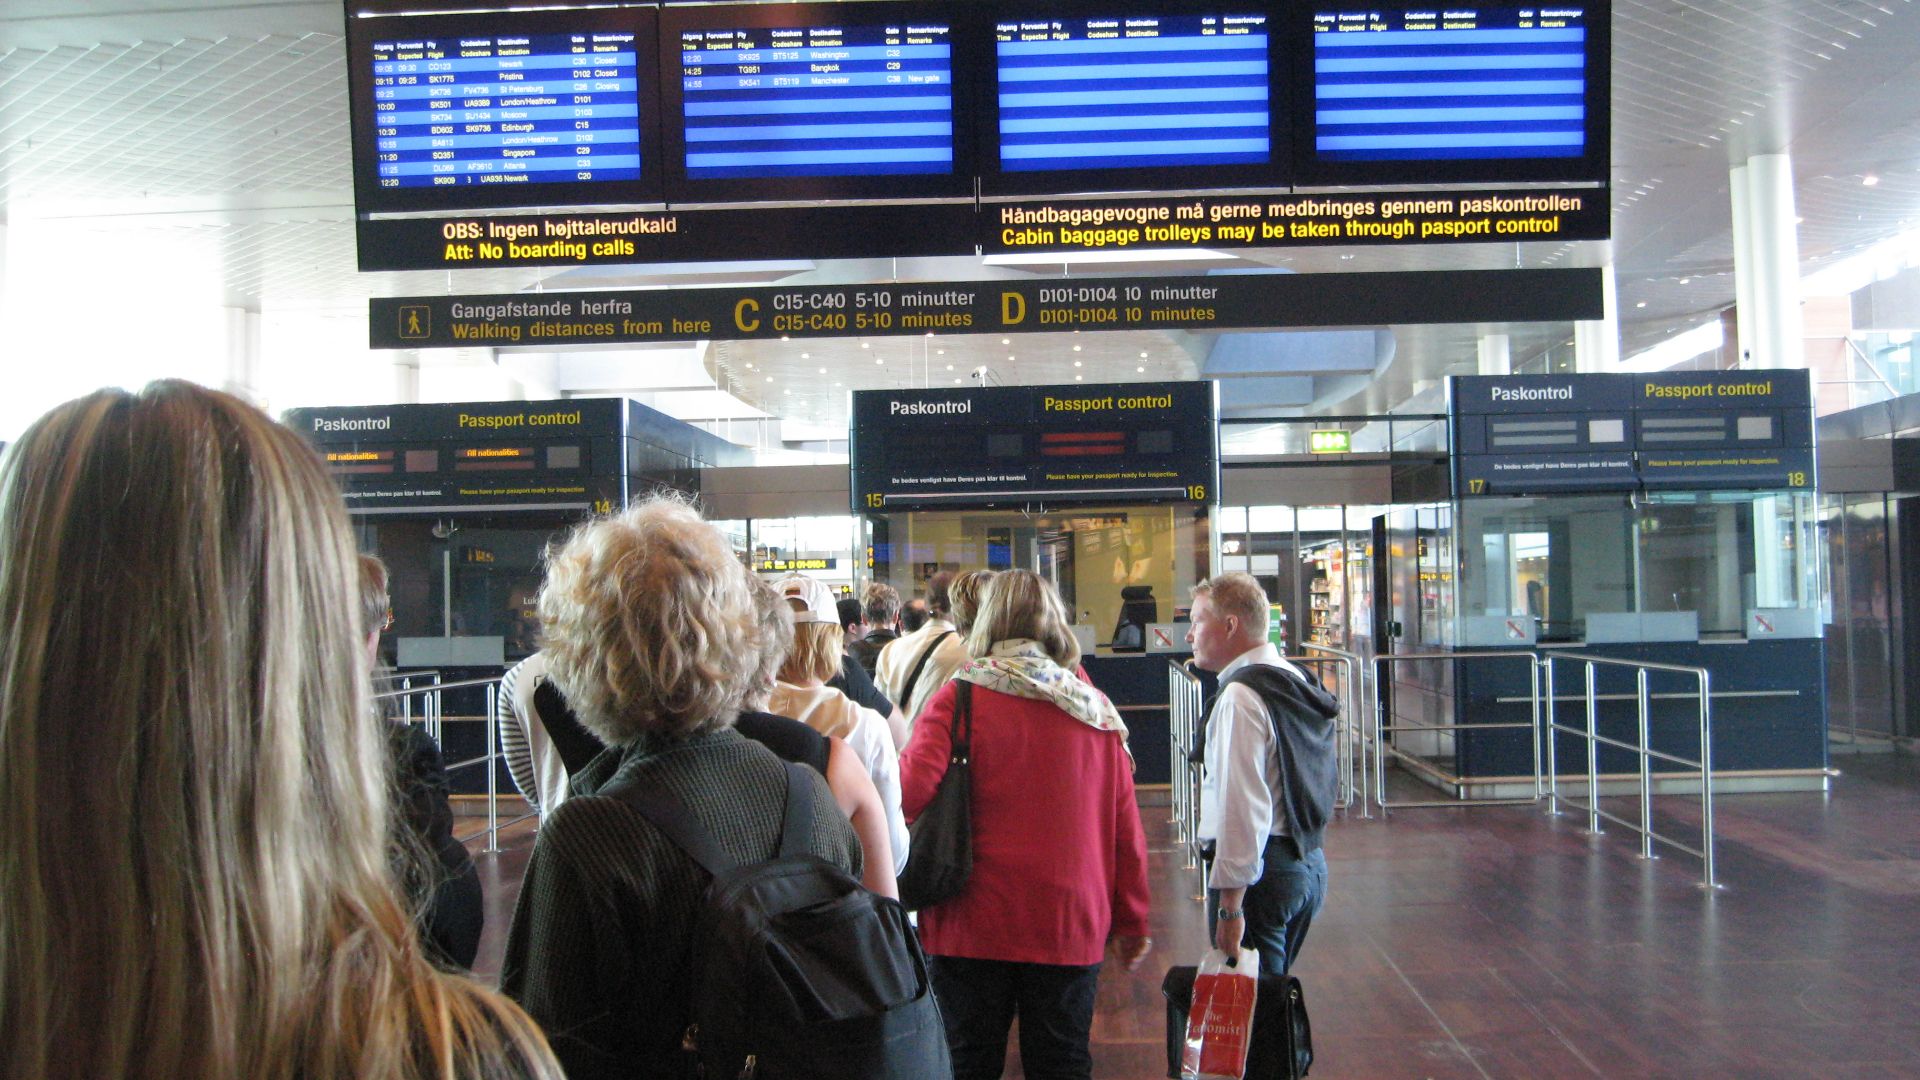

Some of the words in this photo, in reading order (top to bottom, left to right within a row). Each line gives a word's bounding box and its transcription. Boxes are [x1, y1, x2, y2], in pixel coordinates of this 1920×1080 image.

[810, 52, 849, 60] Washington
[811, 64, 839, 73] Bangkok
[596, 83, 620, 92] Closing
[502, 124, 534, 132] Edinburgh
[503, 150, 535, 158] Singapore
[1001, 206, 1169, 225] Håndbagagevogne
[1177, 203, 1203, 219] må
[1211, 204, 1261, 222] gerne
[1268, 200, 1375, 219] medbringes
[1382, 203, 1453, 218] gennem
[1460, 196, 1581, 216] paskontrollen
[444, 222, 483, 239] OBS:
[490, 222, 538, 241] Ingen
[545, 217, 677, 239] højttalerudkald
[1002, 228, 1054, 245] Cabin
[1060, 228, 1139, 246] baggage
[1145, 225, 1211, 243] trolleys
[1218, 226, 1255, 242] may
[1263, 222, 1284, 238] be
[1290, 220, 1340, 237] taken
[1346, 218, 1414, 239] through
[1422, 218, 1490, 238] pasport
[1496, 217, 1558, 234] control
[445, 243, 474, 260] Att:
[480, 243, 503, 259] No
[510, 241, 587, 260] boarding
[593, 240, 634, 256] calls
[452, 300, 571, 321] Gangafstande
[581, 300, 632, 316] herfra
[735, 298, 760, 332] C
[774, 293, 845, 310] C15-C40
[856, 292, 891, 308] 5-10
[902, 291, 975, 306] minutter
[1002, 292, 1026, 324] D
[1040, 287, 1117, 303] D101-D104
[1125, 287, 1141, 301] 10
[1151, 286, 1218, 300] minutter
[774, 314, 846, 331] C15-C40
[856, 312, 891, 328] 5-10
[902, 312, 972, 327] minutes
[1040, 307, 1117, 323] D101-D104
[1125, 307, 1141, 321] 10
[1151, 306, 1215, 321] minutes
[452, 322, 520, 341] Walking
[530, 320, 614, 337] distances
[623, 319, 663, 334] from
[672, 318, 711, 333] here
[1492, 385, 1572, 400] Paskontrol
[1645, 383, 1712, 399] Passport
[1717, 381, 1771, 396] control
[891, 400, 971, 415] Paskontrol
[1045, 397, 1112, 413] Passport
[1118, 394, 1171, 409] control
[314, 417, 390, 431] Paskontrol
[459, 413, 524, 429] Passport
[529, 411, 581, 425] control
[338, 452, 378, 460] nationalities
[1469, 479, 1484, 494] 17
[1788, 472, 1805, 486] 18
[1188, 485, 1205, 500] 16
[595, 500, 610, 513] 14
[866, 493, 883, 508] 15
